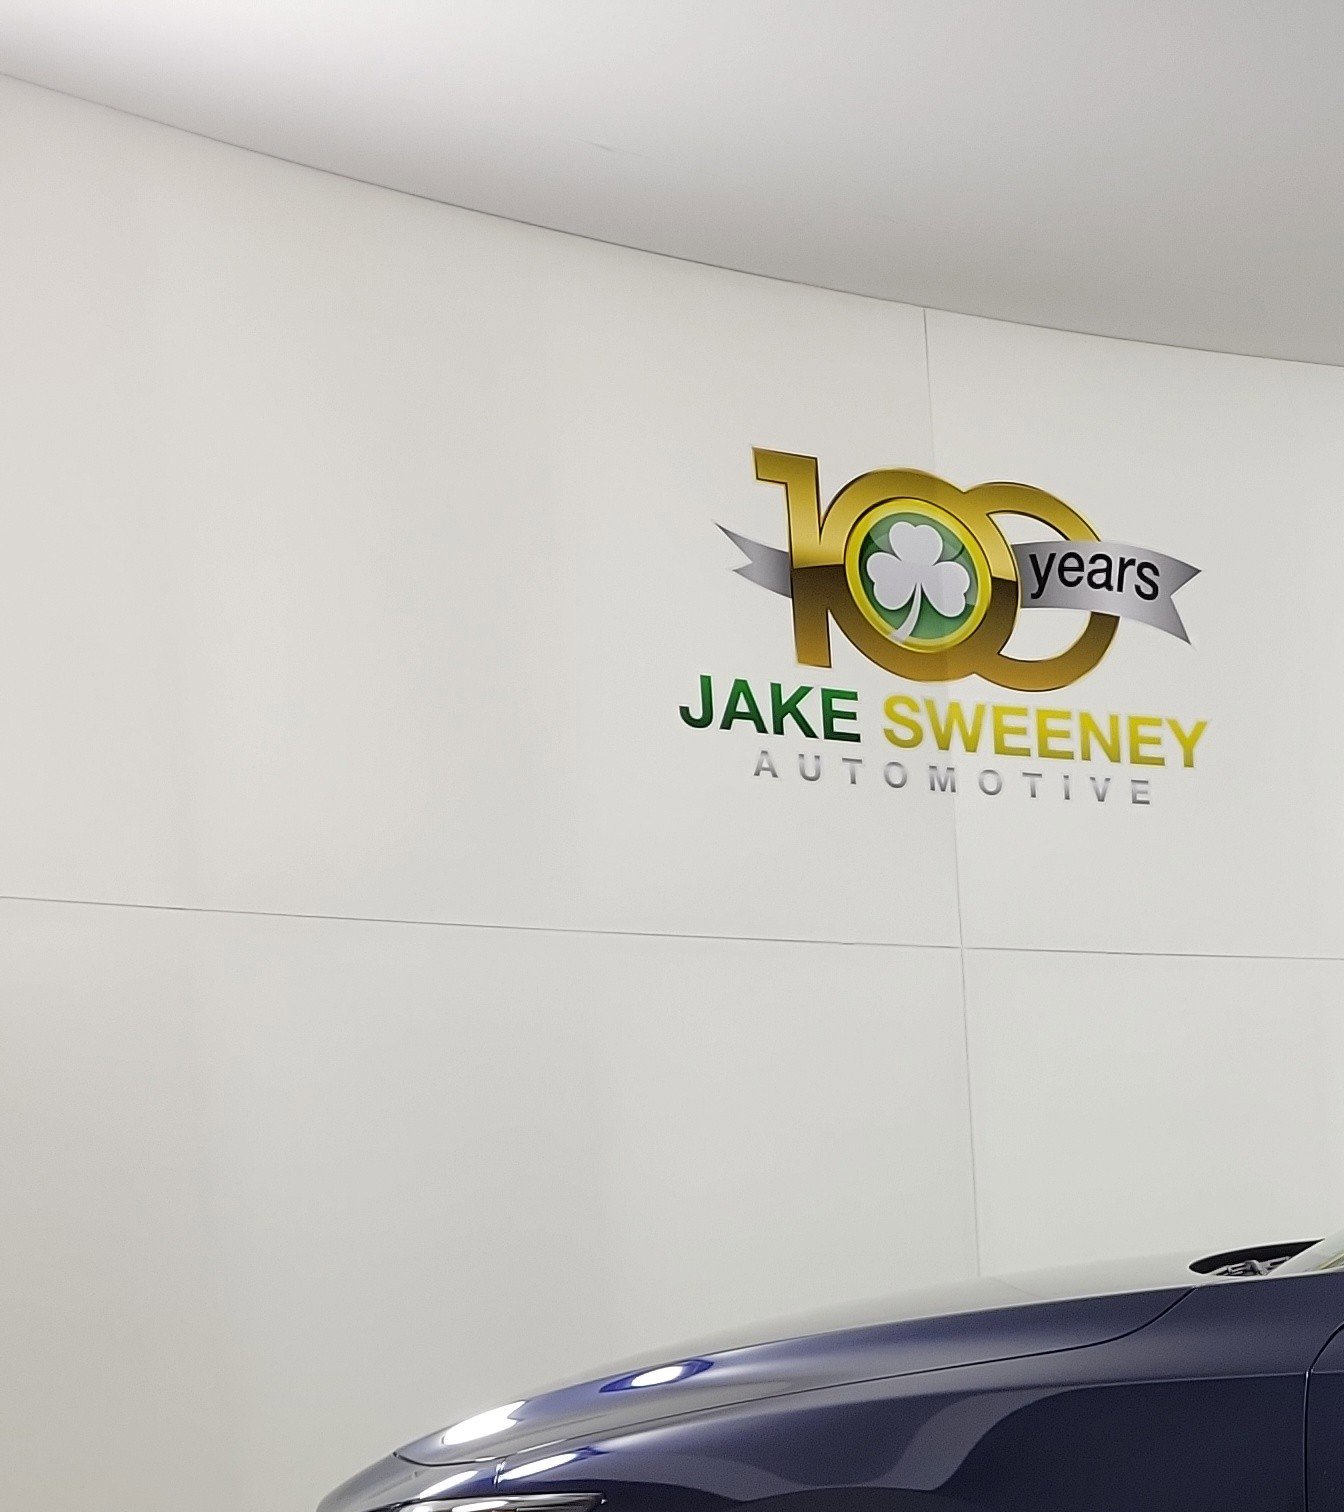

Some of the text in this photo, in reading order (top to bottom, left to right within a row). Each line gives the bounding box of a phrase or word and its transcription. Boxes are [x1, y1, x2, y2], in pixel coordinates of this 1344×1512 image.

[750, 445, 1161, 692] 100 years
[679, 674, 1208, 768] JAKE SWEENEY
[753, 749, 1152, 806] AUTOMOTIVE
